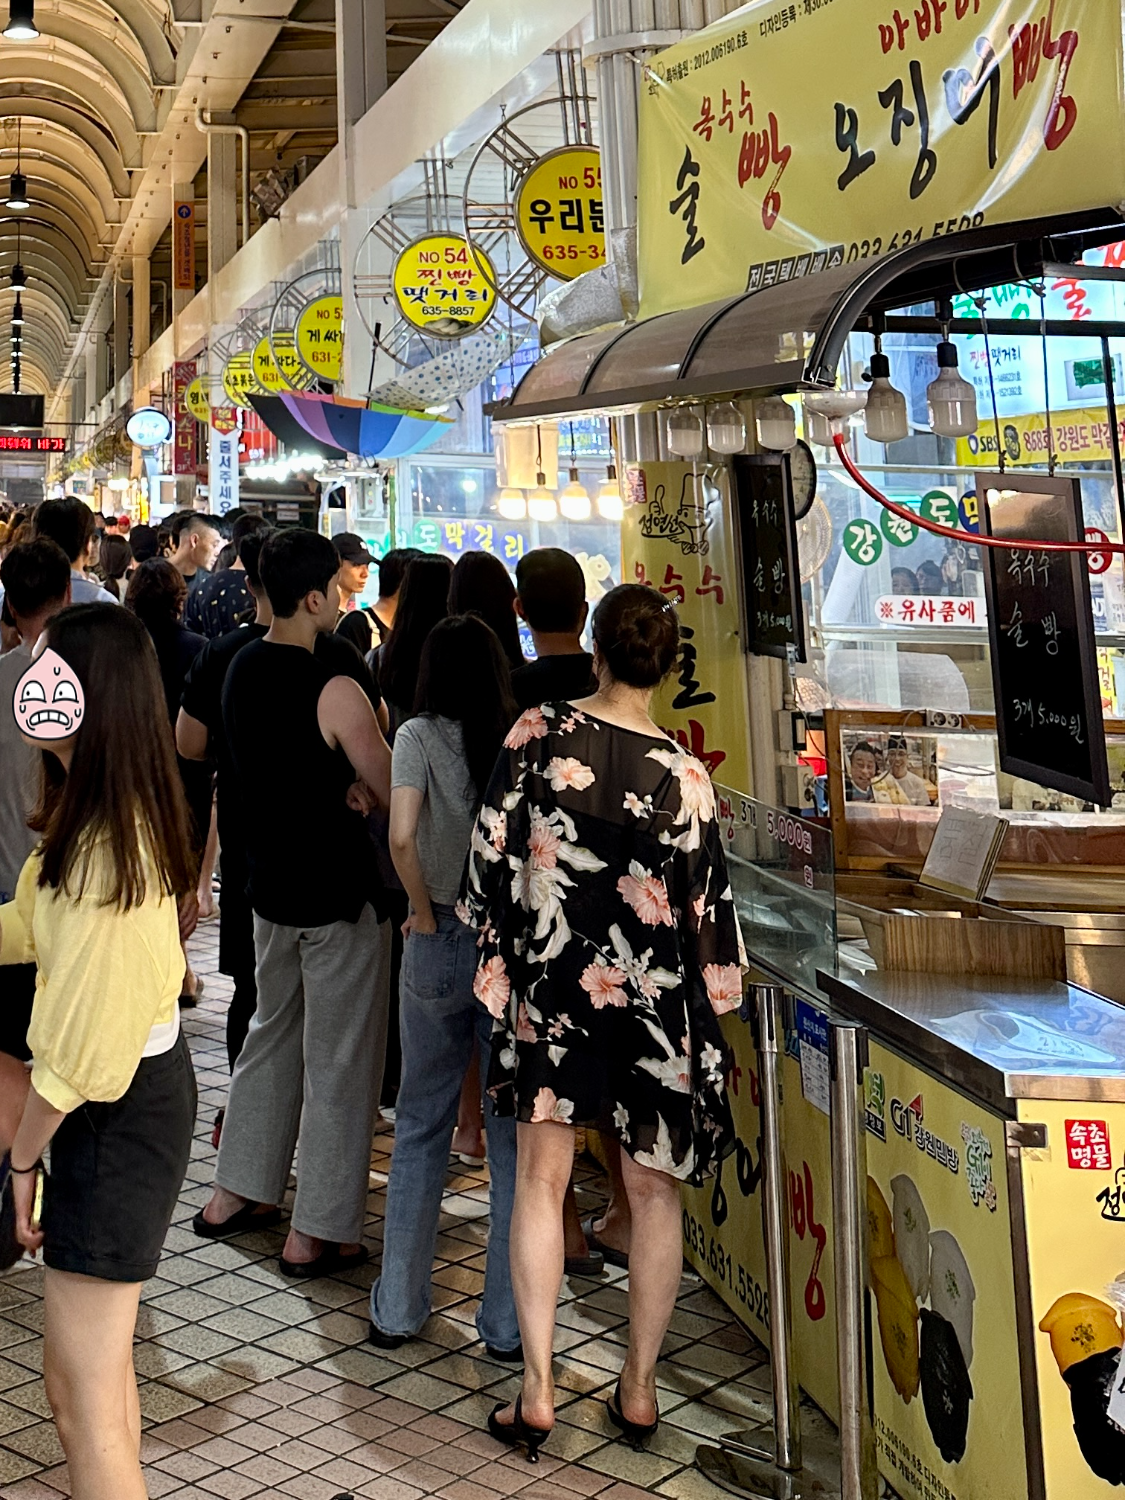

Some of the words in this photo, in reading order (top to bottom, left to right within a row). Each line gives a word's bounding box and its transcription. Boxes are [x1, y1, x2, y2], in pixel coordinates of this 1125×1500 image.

[693, 79, 754, 142] 옥수수
[558, 176, 579, 190] NO
[419, 251, 440, 264] NO
[444, 247, 468, 264] 54
[421, 306, 476, 316] 635-8857
[1056, 424, 1091, 453] 강원도
[1069, 1121, 1106, 1146] 속초
[1070, 1143, 1111, 1169] 명물
